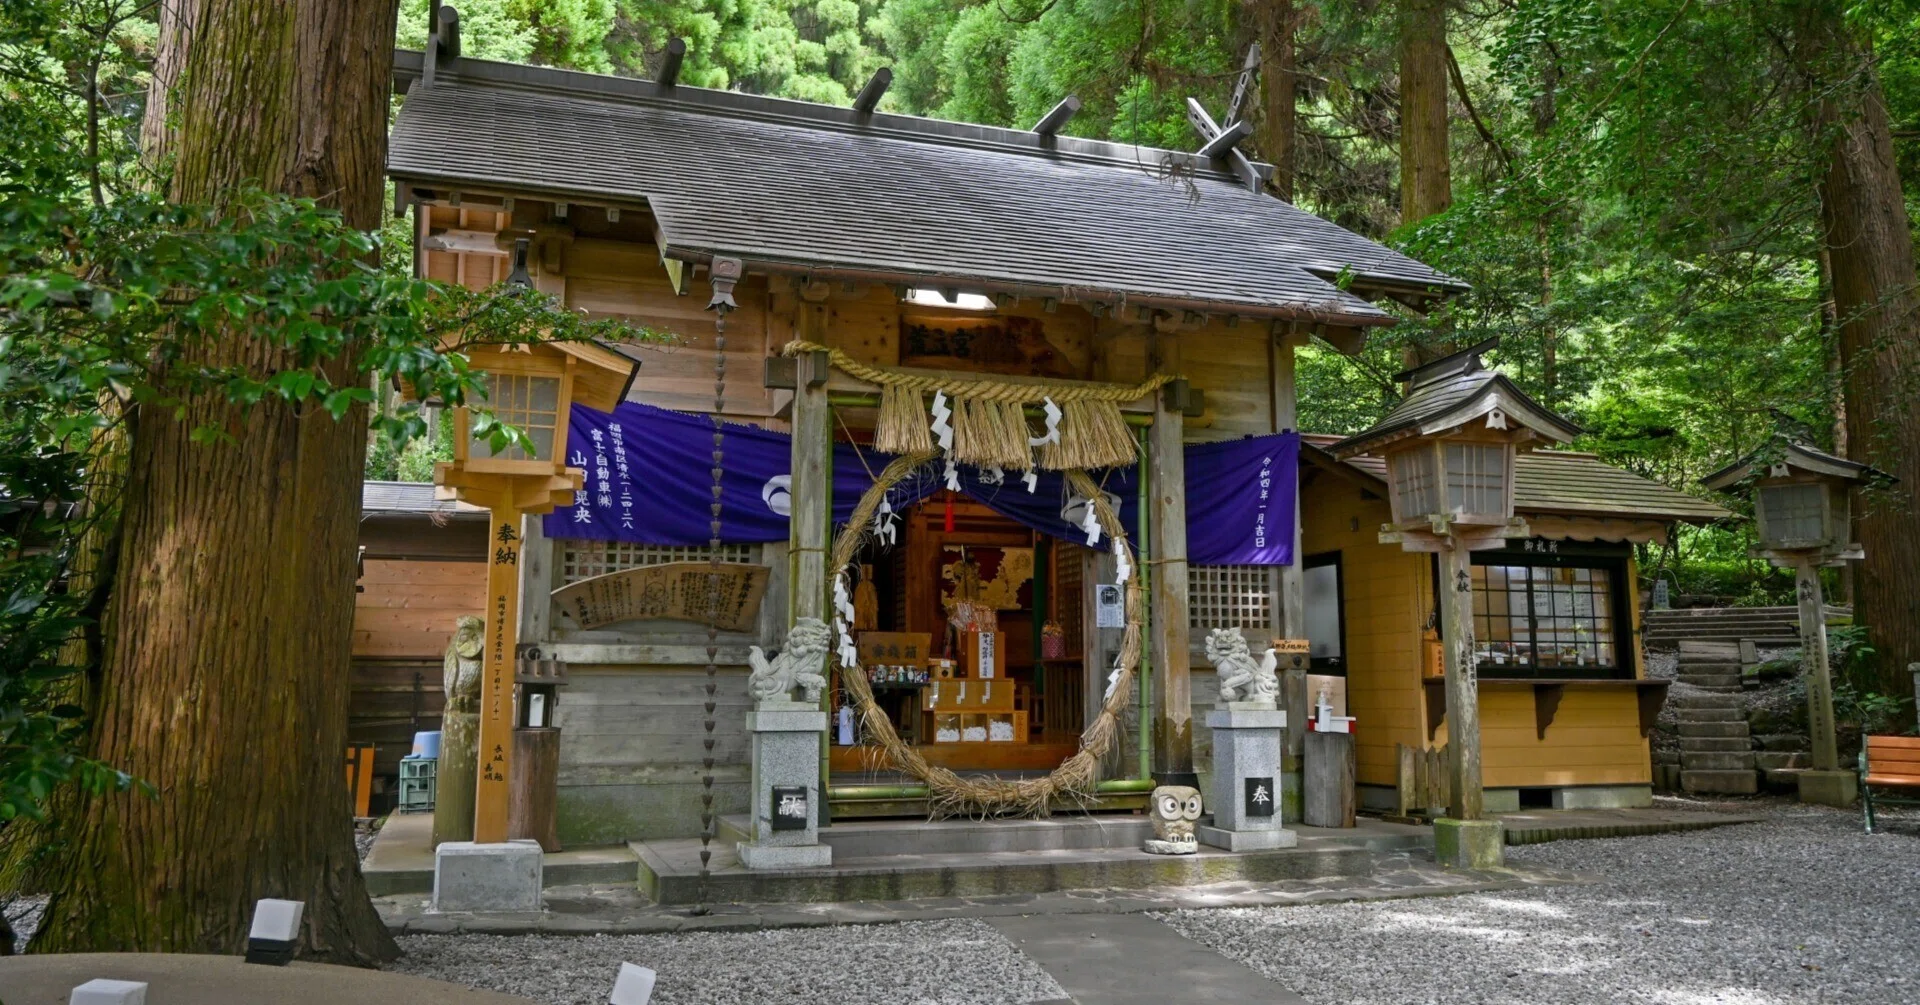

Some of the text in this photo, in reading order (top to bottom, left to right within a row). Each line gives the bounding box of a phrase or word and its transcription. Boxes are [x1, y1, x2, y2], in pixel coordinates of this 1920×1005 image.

[1255, 457, 1271, 548] 令和四年一月吉日
[495, 523, 518, 566] 奉納
[1252, 784, 1270, 805] 奉
